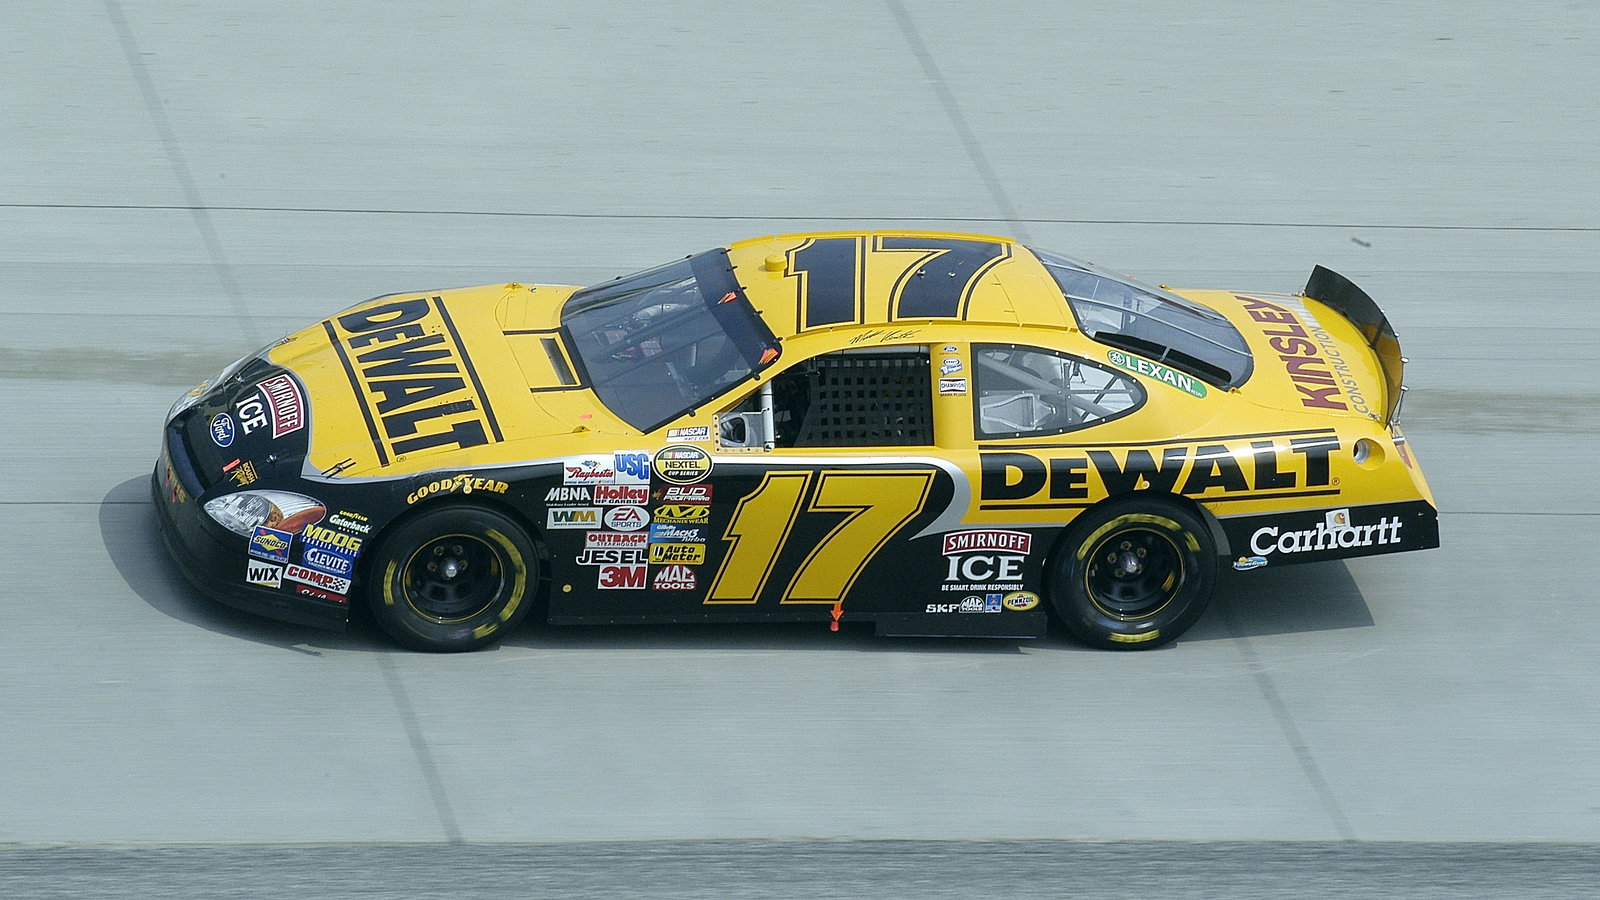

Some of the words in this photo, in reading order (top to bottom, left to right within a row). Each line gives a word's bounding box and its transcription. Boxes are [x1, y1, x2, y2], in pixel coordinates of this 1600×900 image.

[784, 235, 1012, 334] 17
[1234, 295, 1349, 411] KINSLEY
[337, 298, 489, 456] DEWALT
[1125, 355, 1192, 393] LEXAN
[1312, 325, 1369, 414] CONSTRUCTION
[264, 377, 299, 430] SMIRNOFF
[236, 393, 269, 436] ICE
[212, 417, 232, 441] Ford
[681, 427, 706, 436] NASCAR
[675, 451, 699, 459] NASCAR
[615, 454, 649, 480] USG
[665, 460, 701, 468] NEXTEL
[979, 436, 1341, 501] DEWALT
[565, 467, 614, 481] Raybestos
[407, 474, 509, 505] GOODYEAR
[544, 487, 592, 501] MBNA
[595, 486, 648, 504] Holley
[667, 487, 707, 496] BUD
[553, 511, 597, 522] WM
[613, 508, 642, 521] EA
[329, 514, 370, 534] Gatorback
[302, 523, 363, 552] MOOG
[588, 533, 646, 543] OUTBACK
[663, 529, 699, 538] MACH3
[703, 469, 937, 605] 17
[948, 533, 1026, 550] SMIRNOFF
[1250, 516, 1402, 556] Carhartt
[254, 536, 288, 550] SUNOCO
[665, 545, 696, 554] Auto
[306, 548, 350, 571] CLEVITE
[577, 550, 648, 564] JESEL
[664, 553, 700, 562] Meter
[249, 567, 280, 581] WIX
[288, 566, 334, 585] COMP
[654, 565, 695, 582] MAC
[944, 555, 1025, 581] ICE
[600, 566, 646, 588] 3M
[987, 583, 1024, 591] RESPONSIBLY
[925, 603, 960, 613] SKF
[962, 597, 983, 609] MAC
[1007, 596, 1034, 606] PENNZOIL
